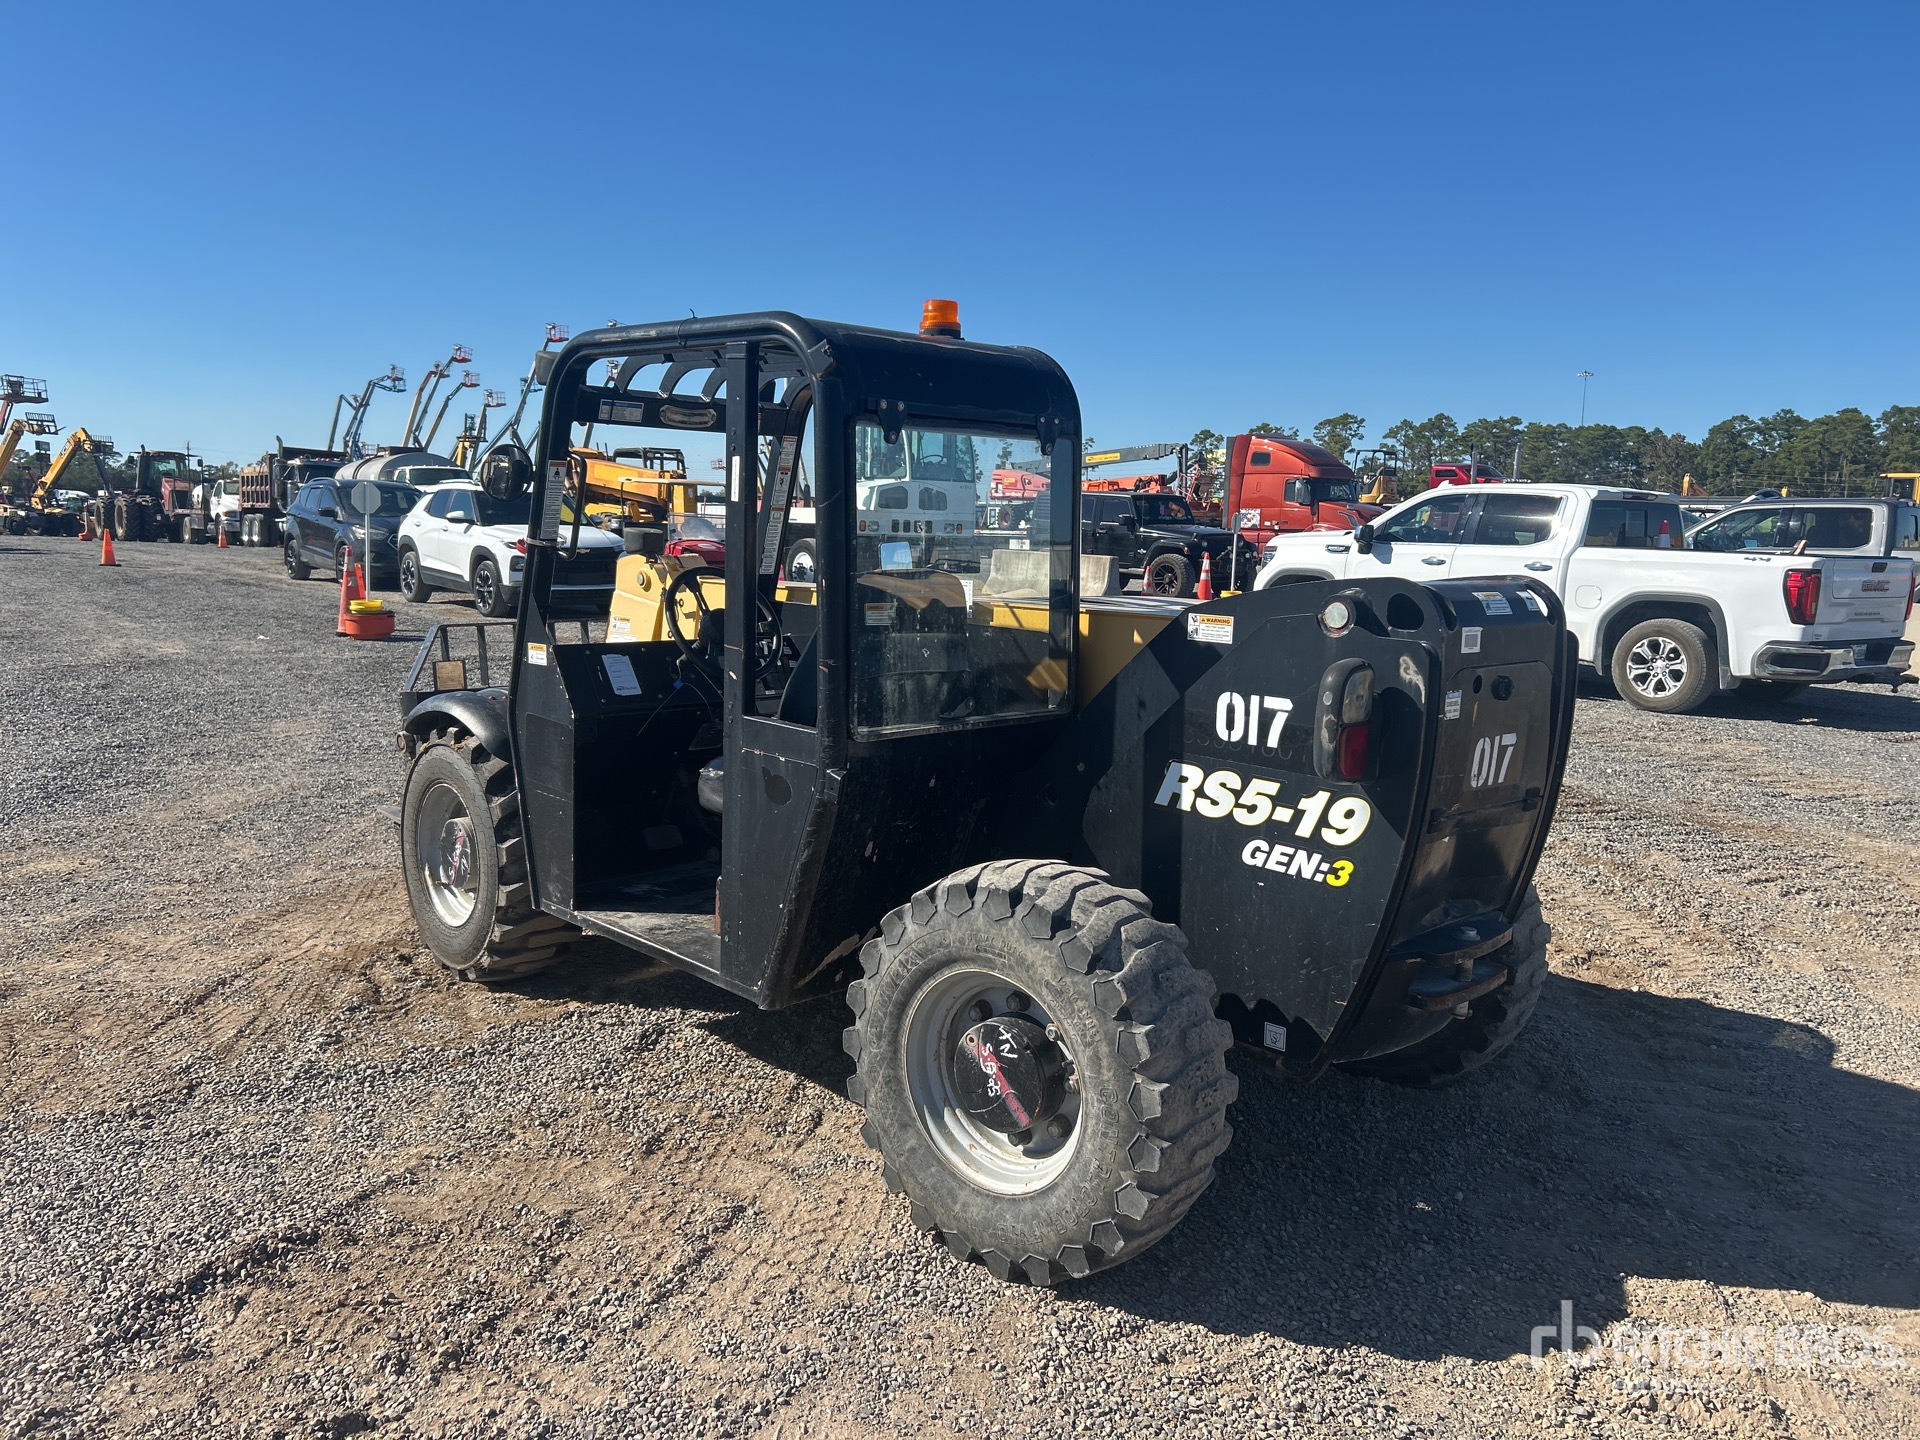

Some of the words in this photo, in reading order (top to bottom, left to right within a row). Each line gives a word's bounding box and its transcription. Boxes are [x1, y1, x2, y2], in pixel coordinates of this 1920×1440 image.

[1861, 579, 1890, 592] GMC
[1215, 691, 1294, 749] 017
[1470, 732, 1517, 788] 017
[1153, 760, 1372, 847] RS5-19
[1241, 838, 1355, 888] GEN:3
